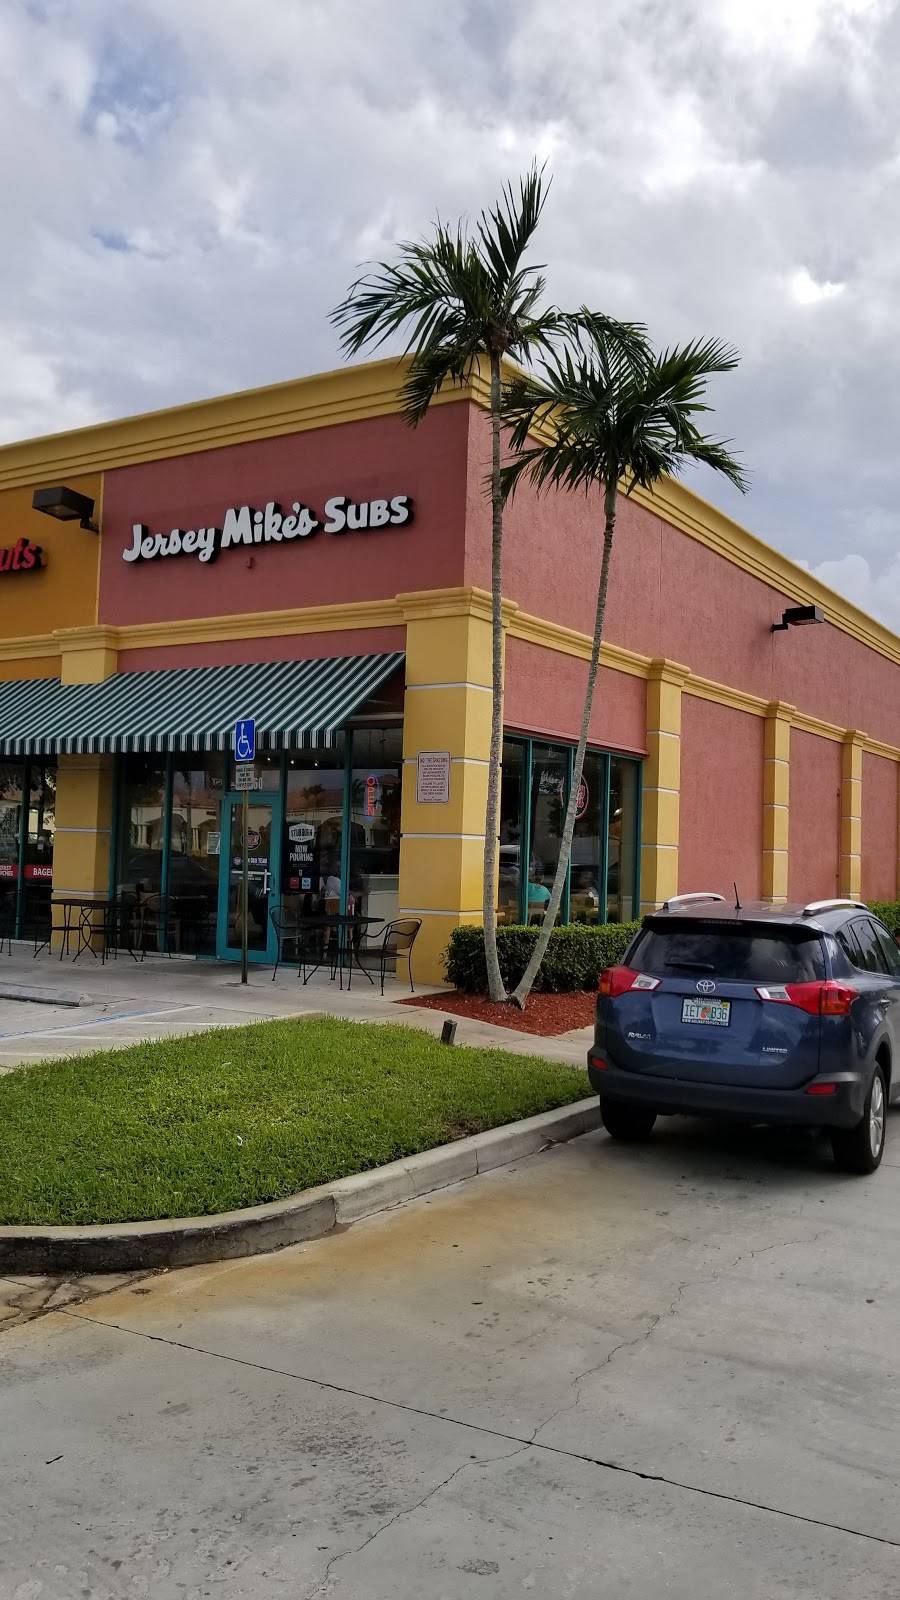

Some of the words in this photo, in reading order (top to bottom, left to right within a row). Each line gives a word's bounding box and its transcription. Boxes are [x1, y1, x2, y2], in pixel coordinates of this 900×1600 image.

[122, 523, 215, 562] Jersey
[220, 502, 318, 547] Mike's
[367, 776, 375, 816] OPEN
[289, 853, 314, 862] POURING
[295, 845, 308, 853] NOW
